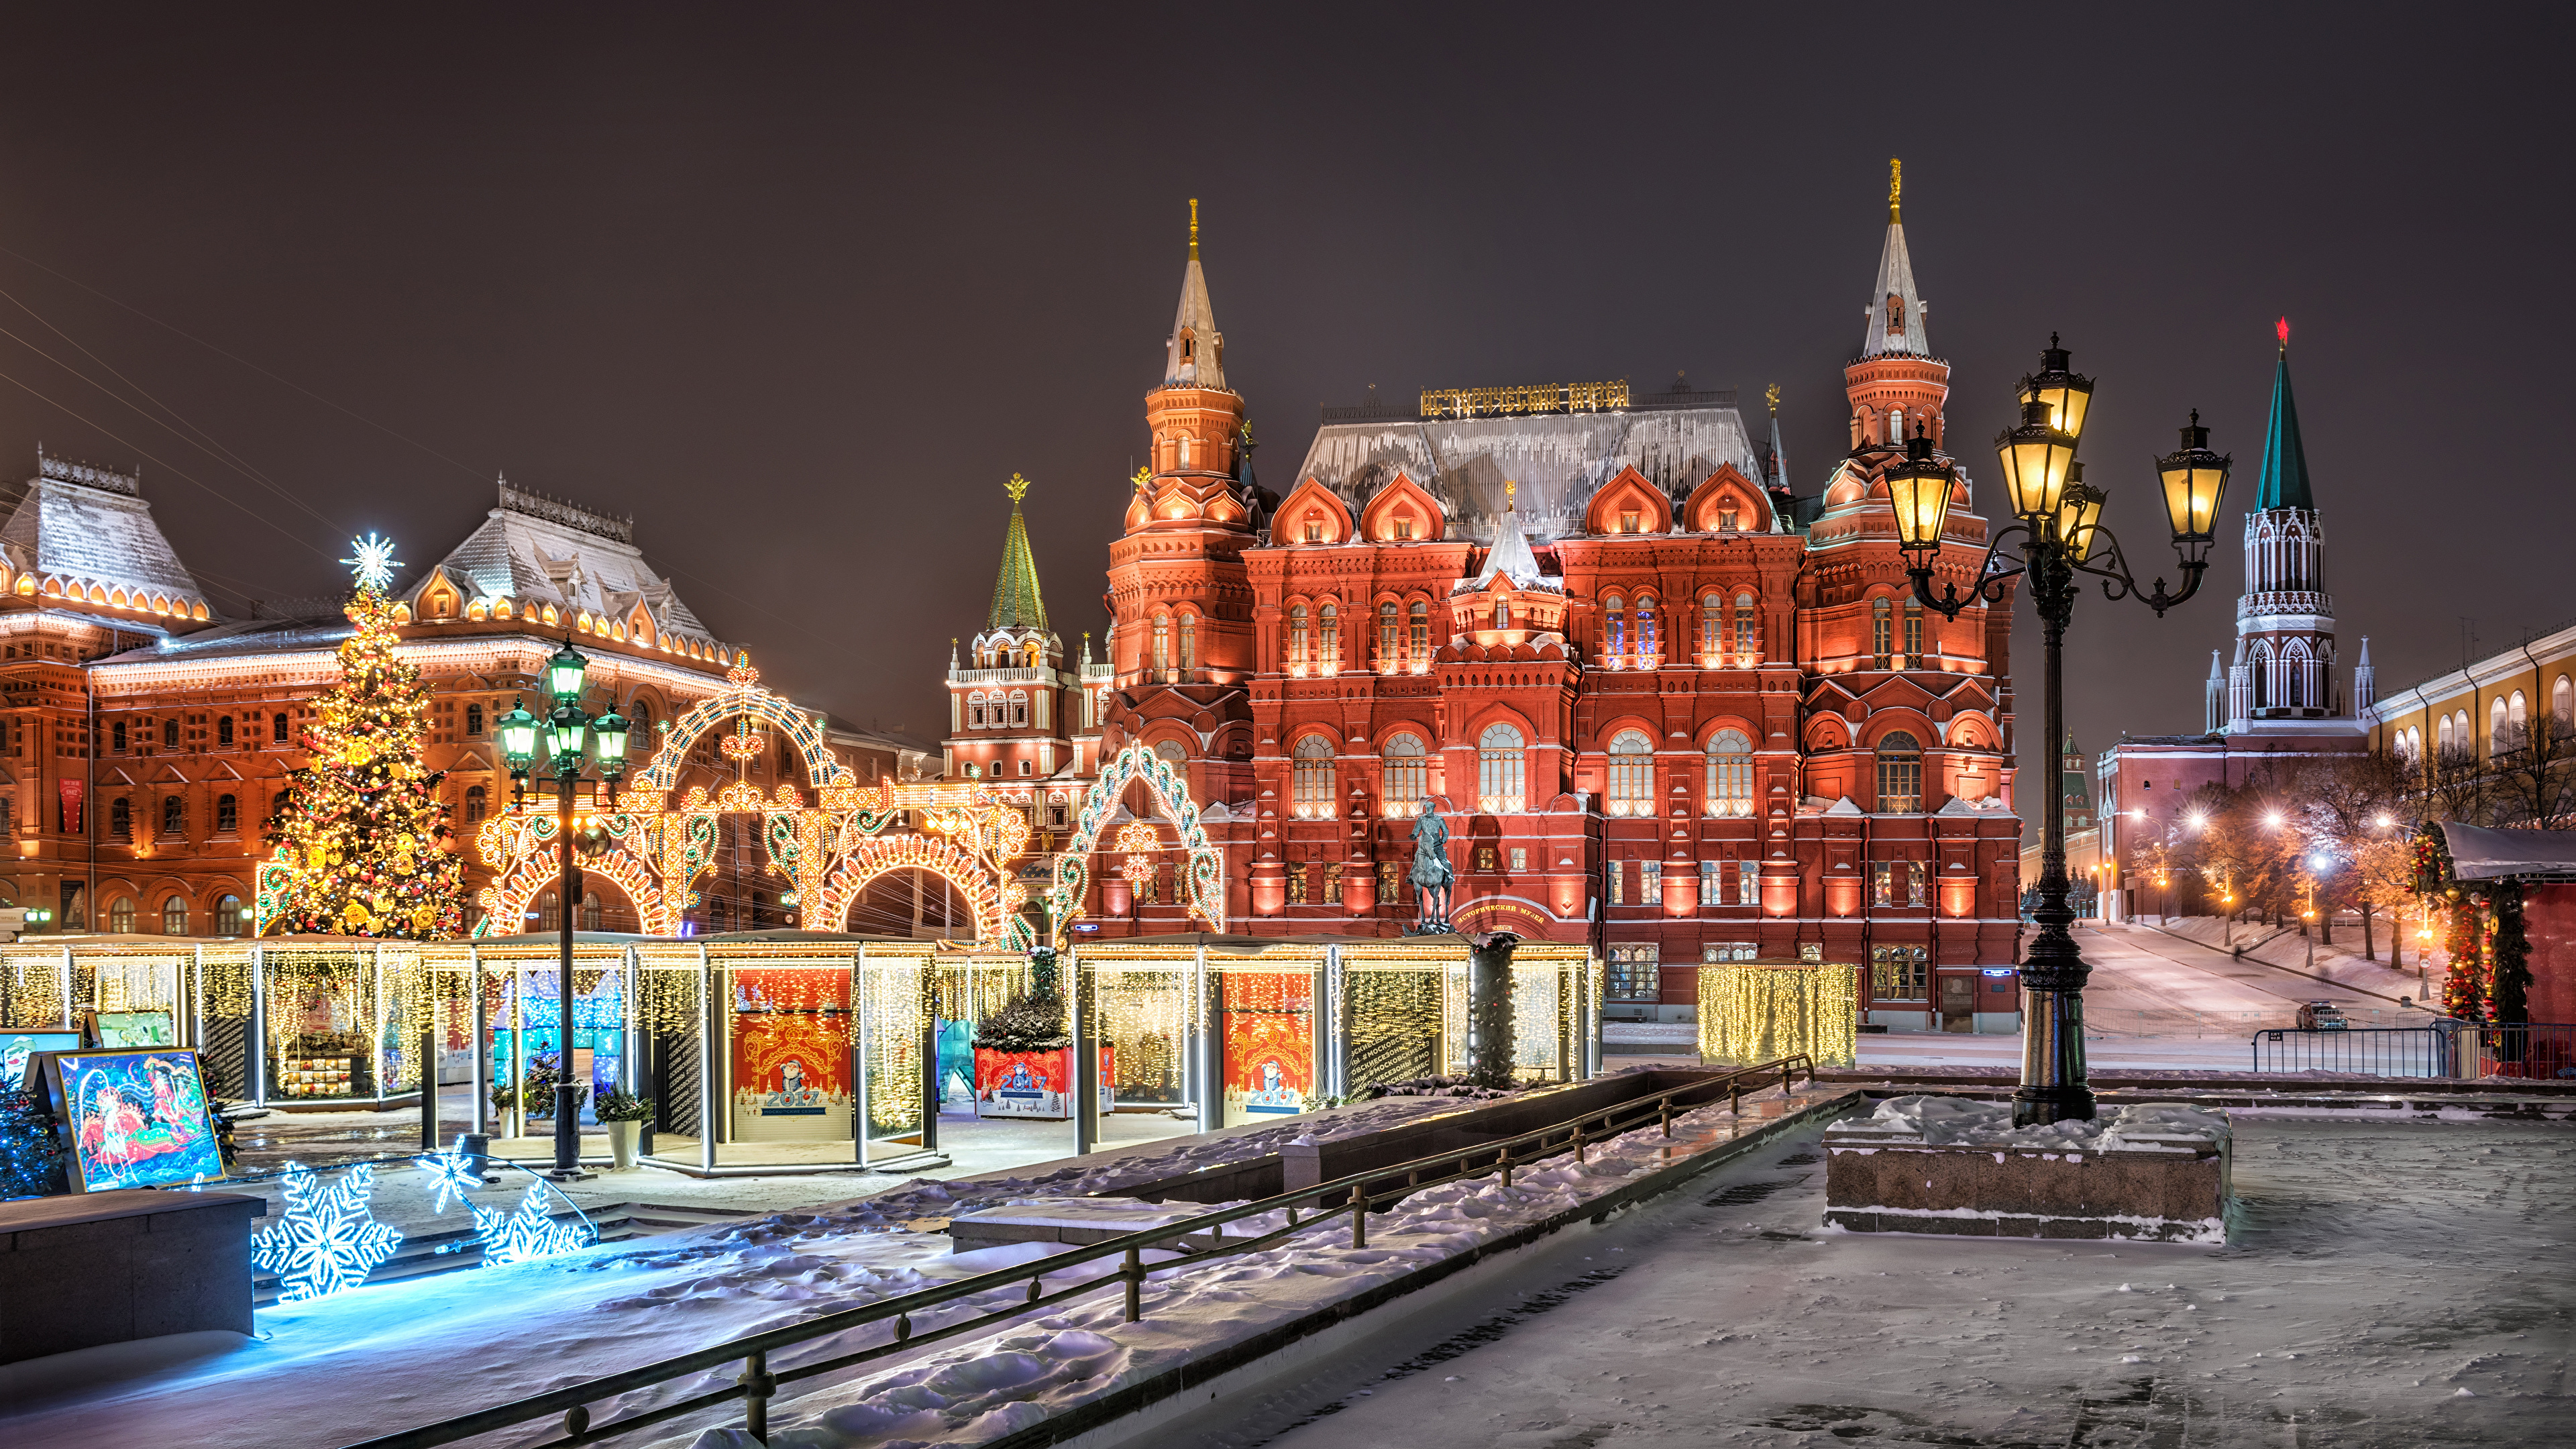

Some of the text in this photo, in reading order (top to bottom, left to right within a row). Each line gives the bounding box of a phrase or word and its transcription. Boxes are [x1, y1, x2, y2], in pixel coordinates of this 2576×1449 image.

[1422, 379, 1627, 415] ИСТОРИЧЕСКИЙ МУЗЕЙ
[1457, 904, 1544, 924] ИСТОРИЧЕСКИЙ МУЗЕЙ
[1001, 1075, 1047, 1091] 2017
[767, 1091, 819, 1107] 2017
[1250, 1089, 1295, 1106] 2017
